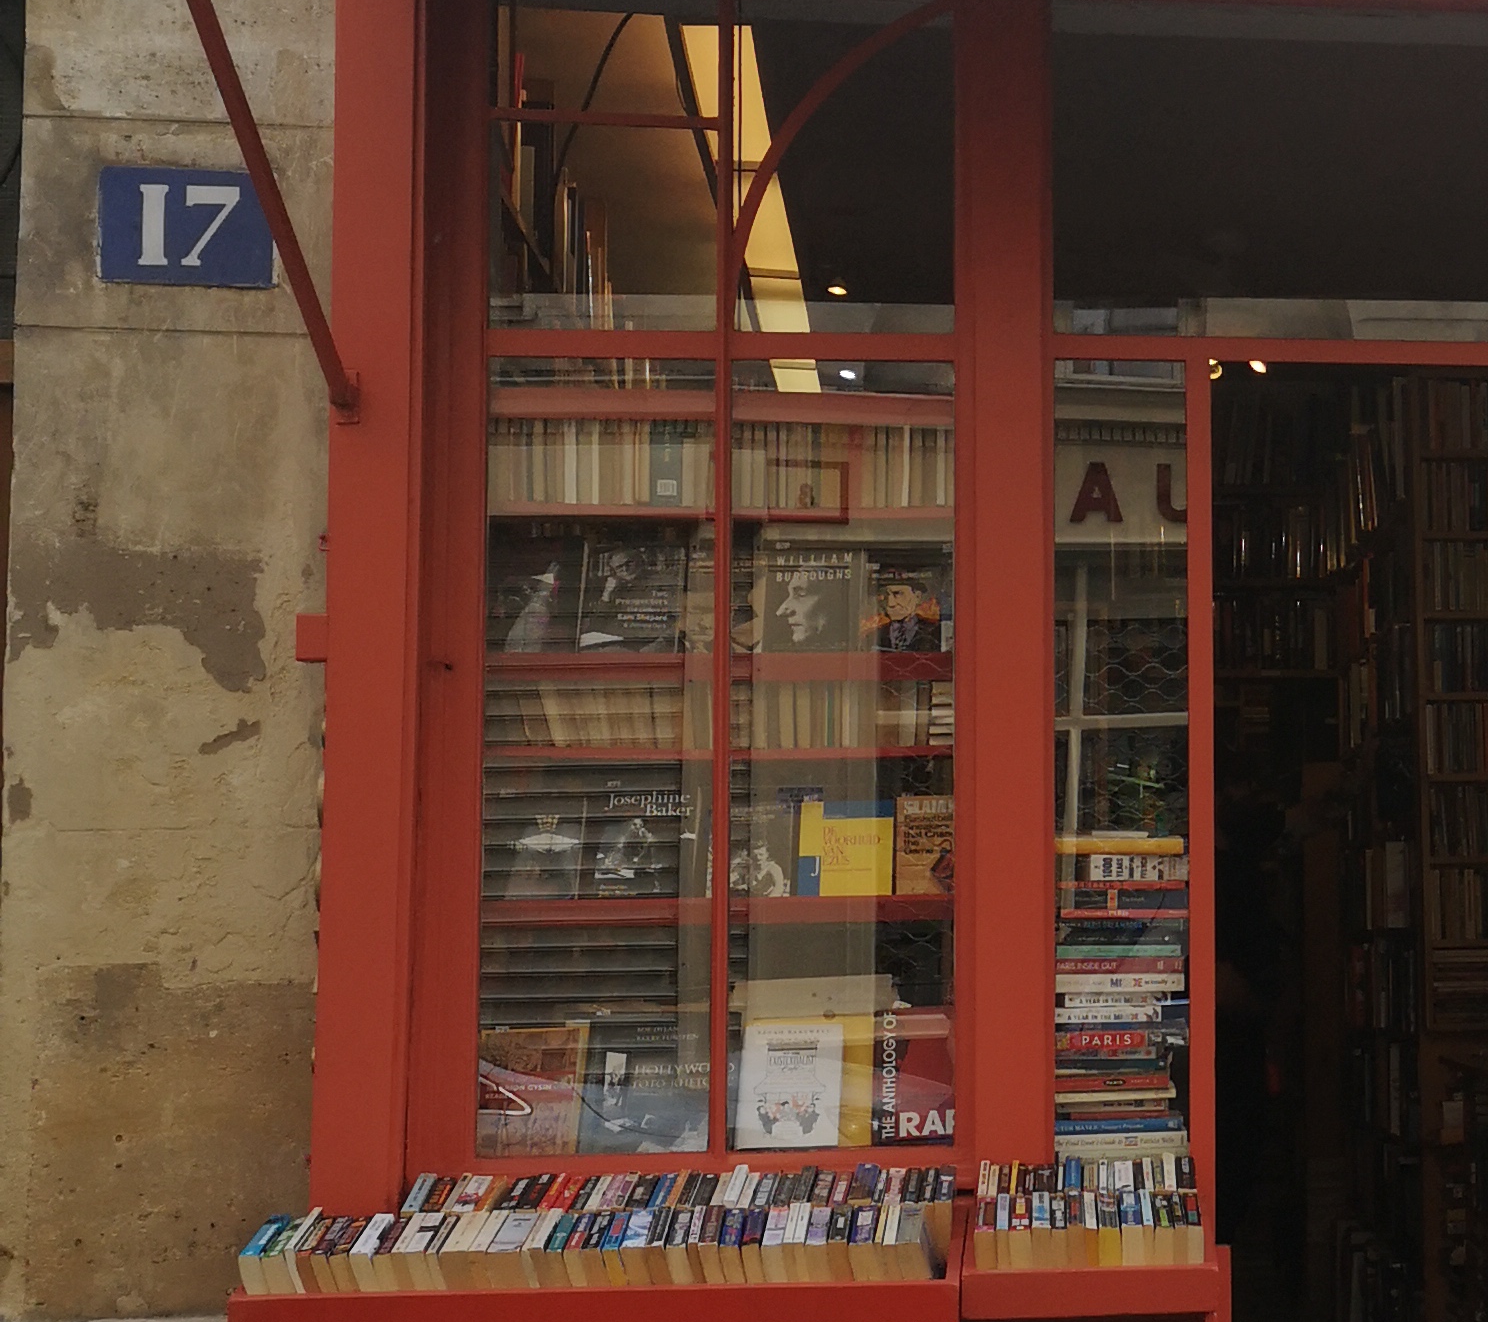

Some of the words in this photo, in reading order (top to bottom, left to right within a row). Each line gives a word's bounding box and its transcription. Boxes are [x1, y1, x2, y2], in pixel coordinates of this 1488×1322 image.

[137, 184, 241, 267] 17
[777, 552, 853, 565] WILLIAM
[776, 570, 851, 582] BURROUGHS
[604, 791, 690, 811] Josephine
[646, 804, 694, 816] Baker
[884, 1012, 897, 1031] OF
[1082, 1034, 1131, 1045] PARIS
[882, 1034, 897, 1111] ANTHOLOGY
[882, 1116, 896, 1139] THE
